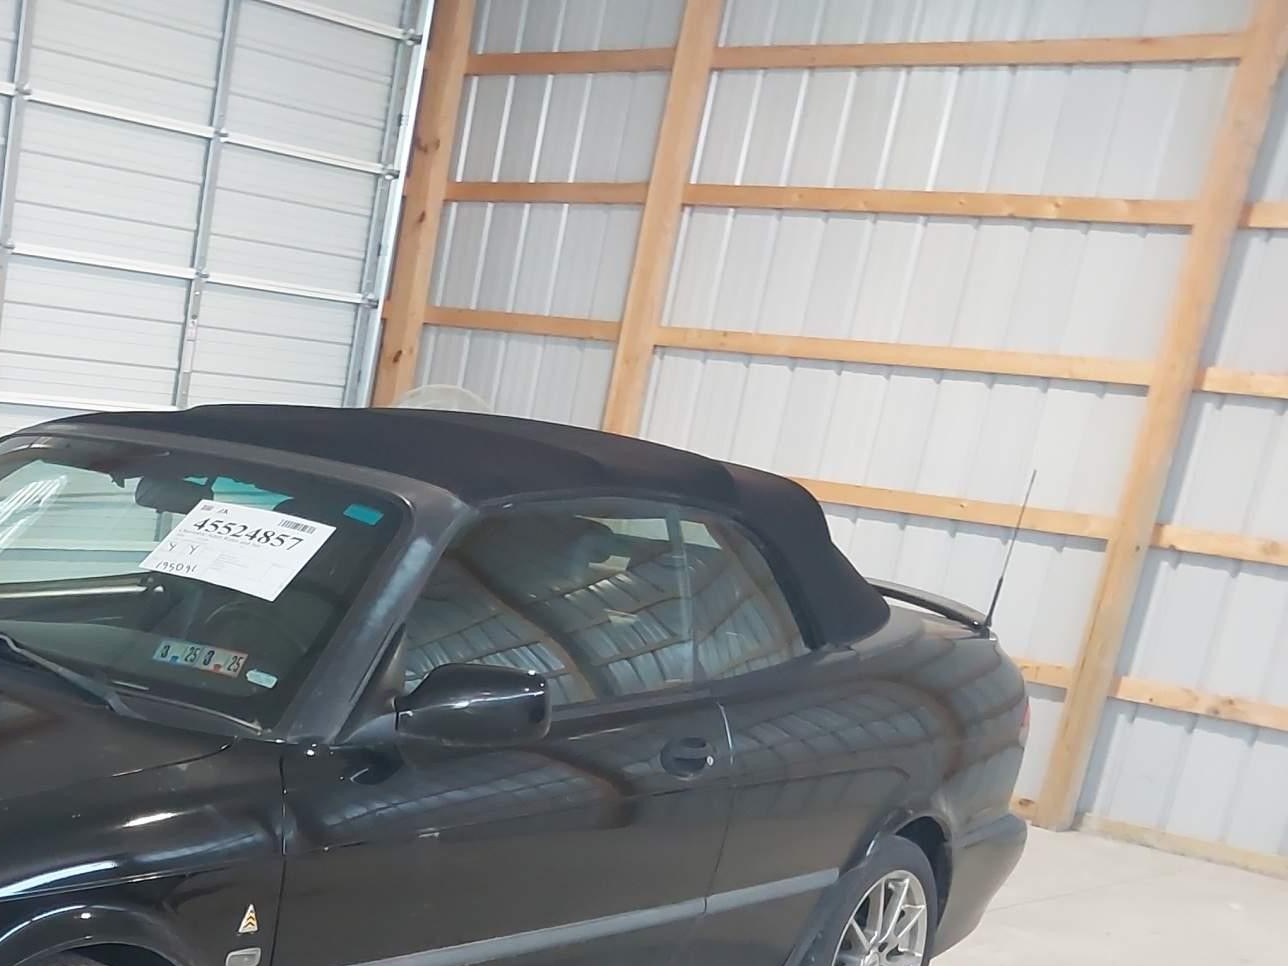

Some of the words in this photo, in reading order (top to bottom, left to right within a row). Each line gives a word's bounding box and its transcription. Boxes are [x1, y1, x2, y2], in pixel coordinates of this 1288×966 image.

[192, 518, 305, 551] 45524857
[184, 646, 201, 663] 25
[226, 655, 243, 673] 25
